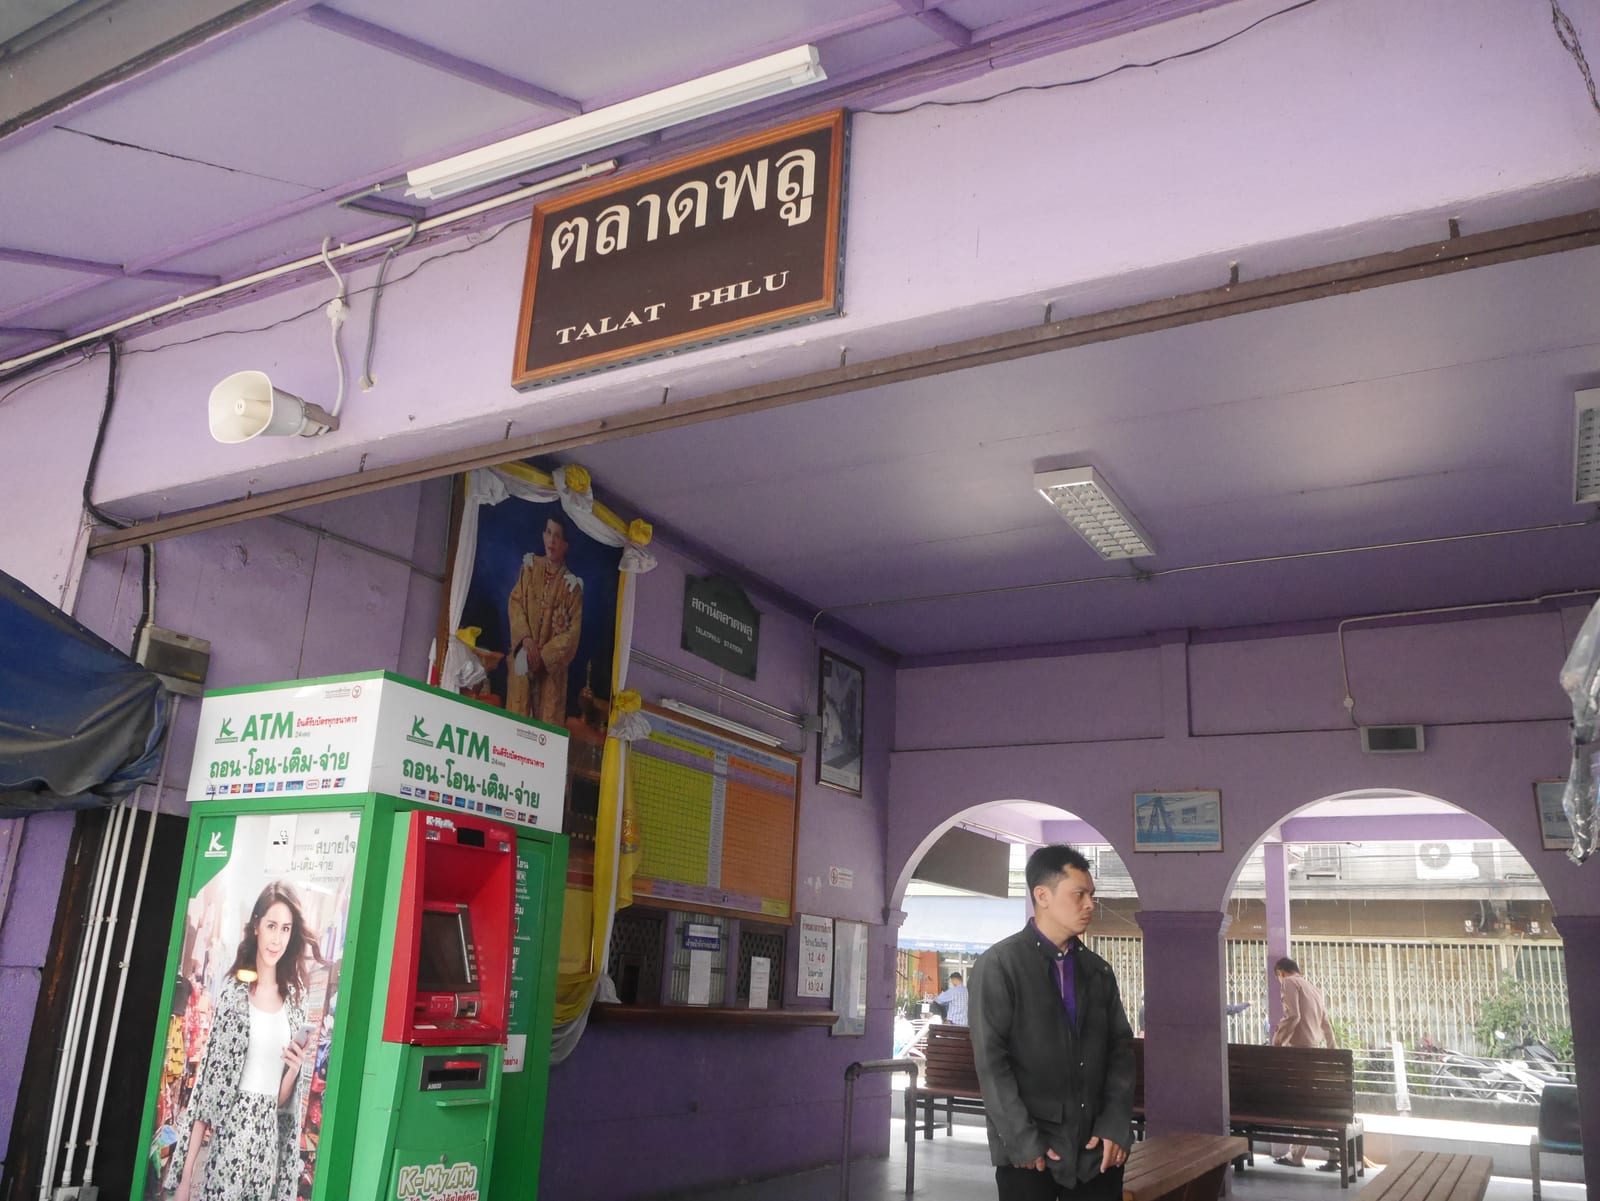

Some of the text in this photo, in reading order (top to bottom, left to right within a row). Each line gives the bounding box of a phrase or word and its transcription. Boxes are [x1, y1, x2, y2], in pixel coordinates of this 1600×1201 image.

[550, 148, 816, 270] ตลาดพลู
[556, 270, 790, 345] TALAT PHLU
[240, 711, 294, 742] ATM
[436, 723, 490, 763] ATM
[209, 744, 350, 778] ถอน-โอน-เติม-จ่าย
[402, 758, 540, 809] ถอน-โอน-เติม-จ่าย
[316, 835, 356, 855] สบายใจ
